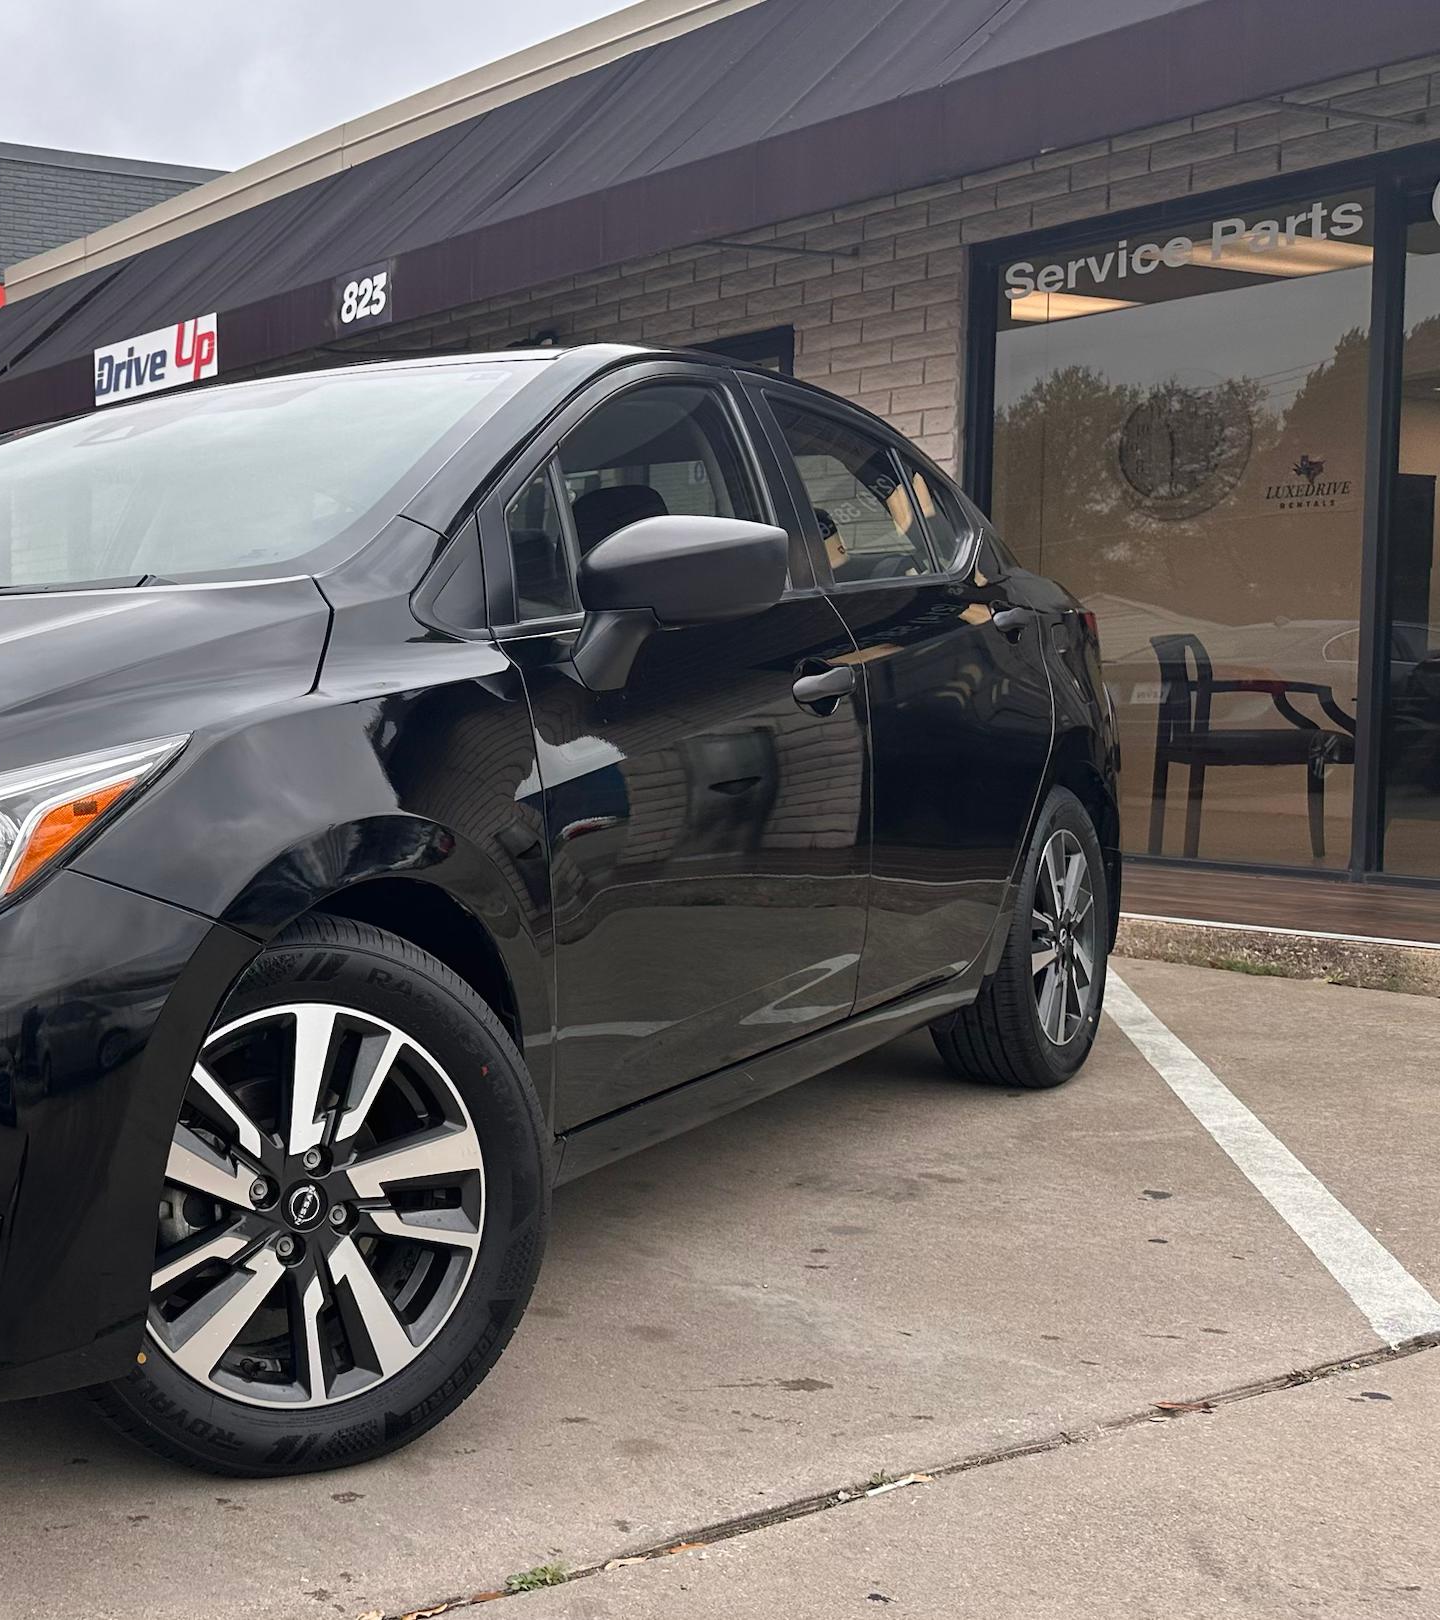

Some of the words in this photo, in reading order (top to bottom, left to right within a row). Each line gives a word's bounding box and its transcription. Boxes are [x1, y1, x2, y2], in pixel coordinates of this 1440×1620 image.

[1004, 240, 1194, 300] Service
[1212, 201, 1364, 261] Parts
[341, 271, 387, 324] 823
[95, 346, 167, 396] Drive
[175, 317, 215, 381] Up
[1265, 480, 1352, 499] LUXEDRIVE
[1280, 499, 1335, 509] RENTALS
[294, 1184, 316, 1226] NISSAN
